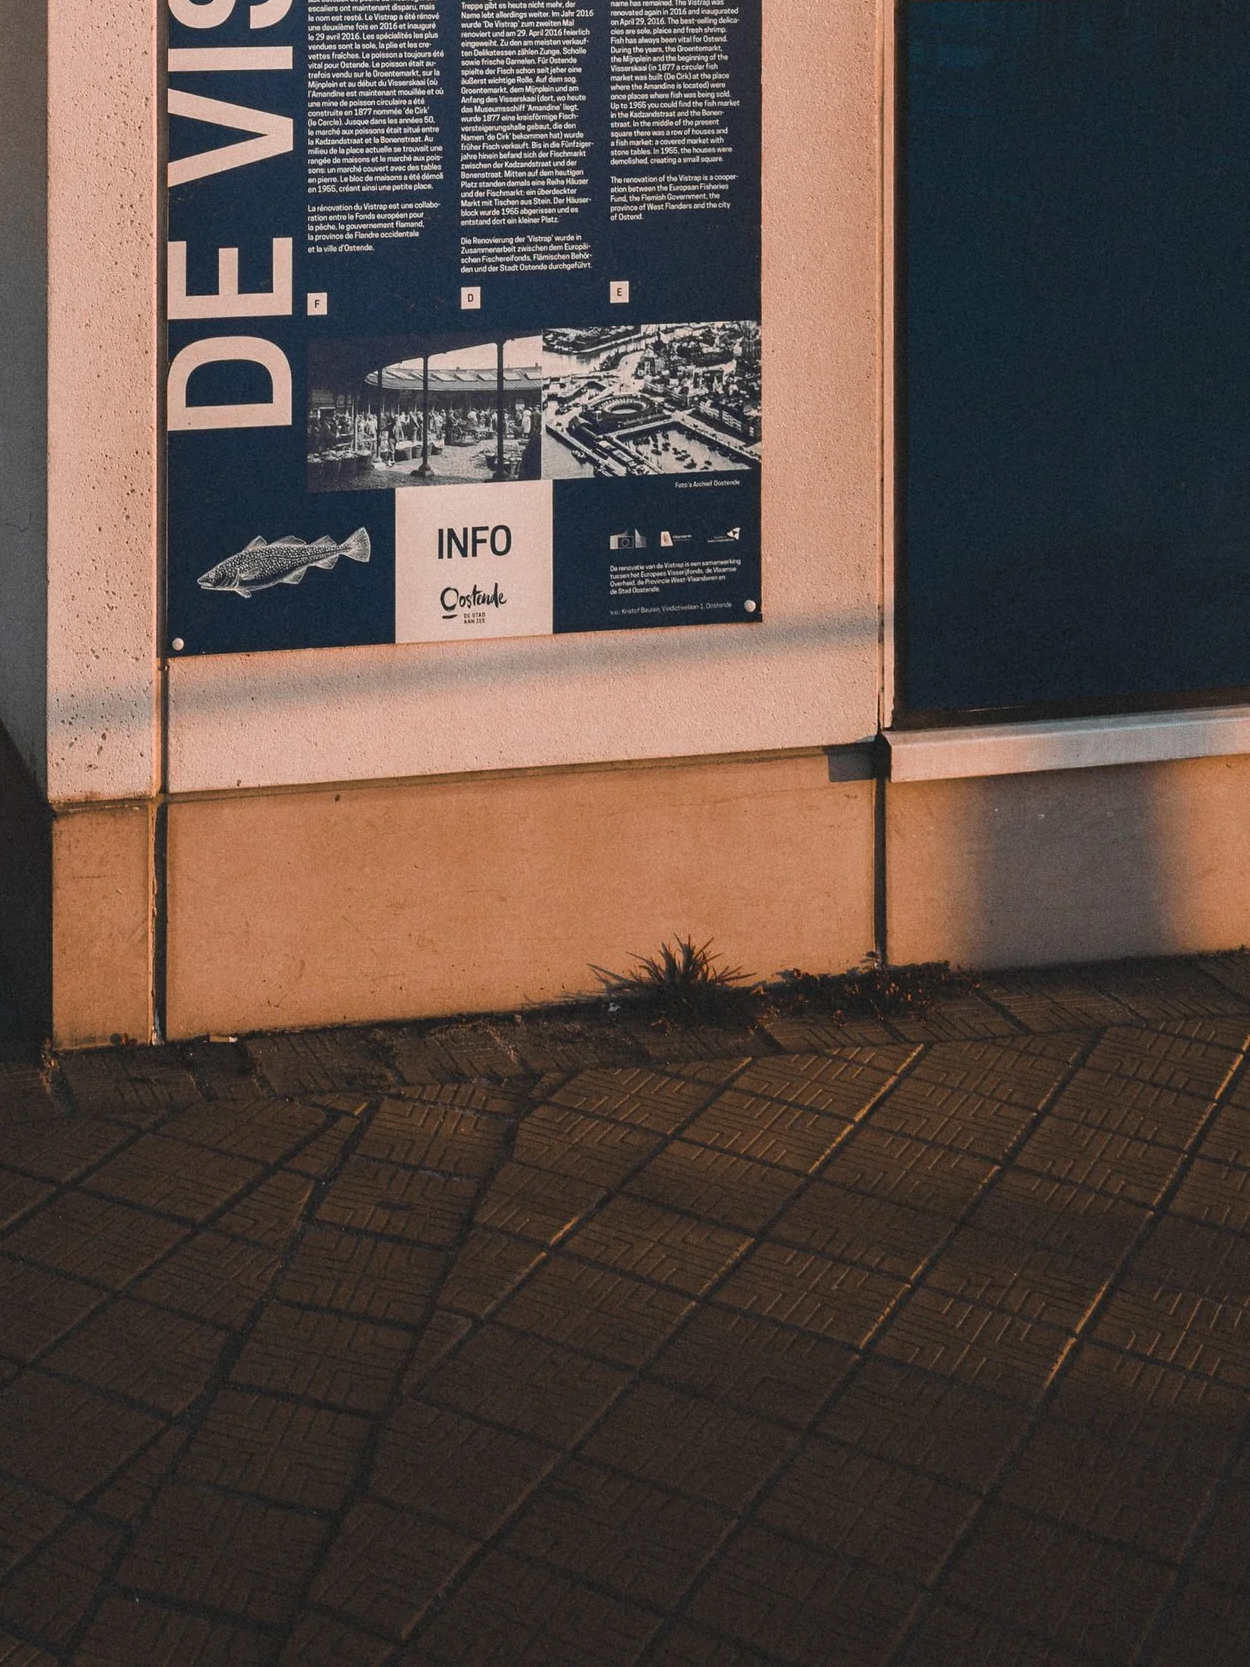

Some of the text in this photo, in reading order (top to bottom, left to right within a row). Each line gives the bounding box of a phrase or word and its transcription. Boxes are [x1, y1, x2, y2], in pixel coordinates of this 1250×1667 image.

[467, 294, 474, 303] D
[616, 288, 623, 297] E
[314, 299, 321, 309] F
[167, 237, 293, 431] DE
[437, 524, 512, 559] INFO
[440, 582, 508, 612] Oostende
